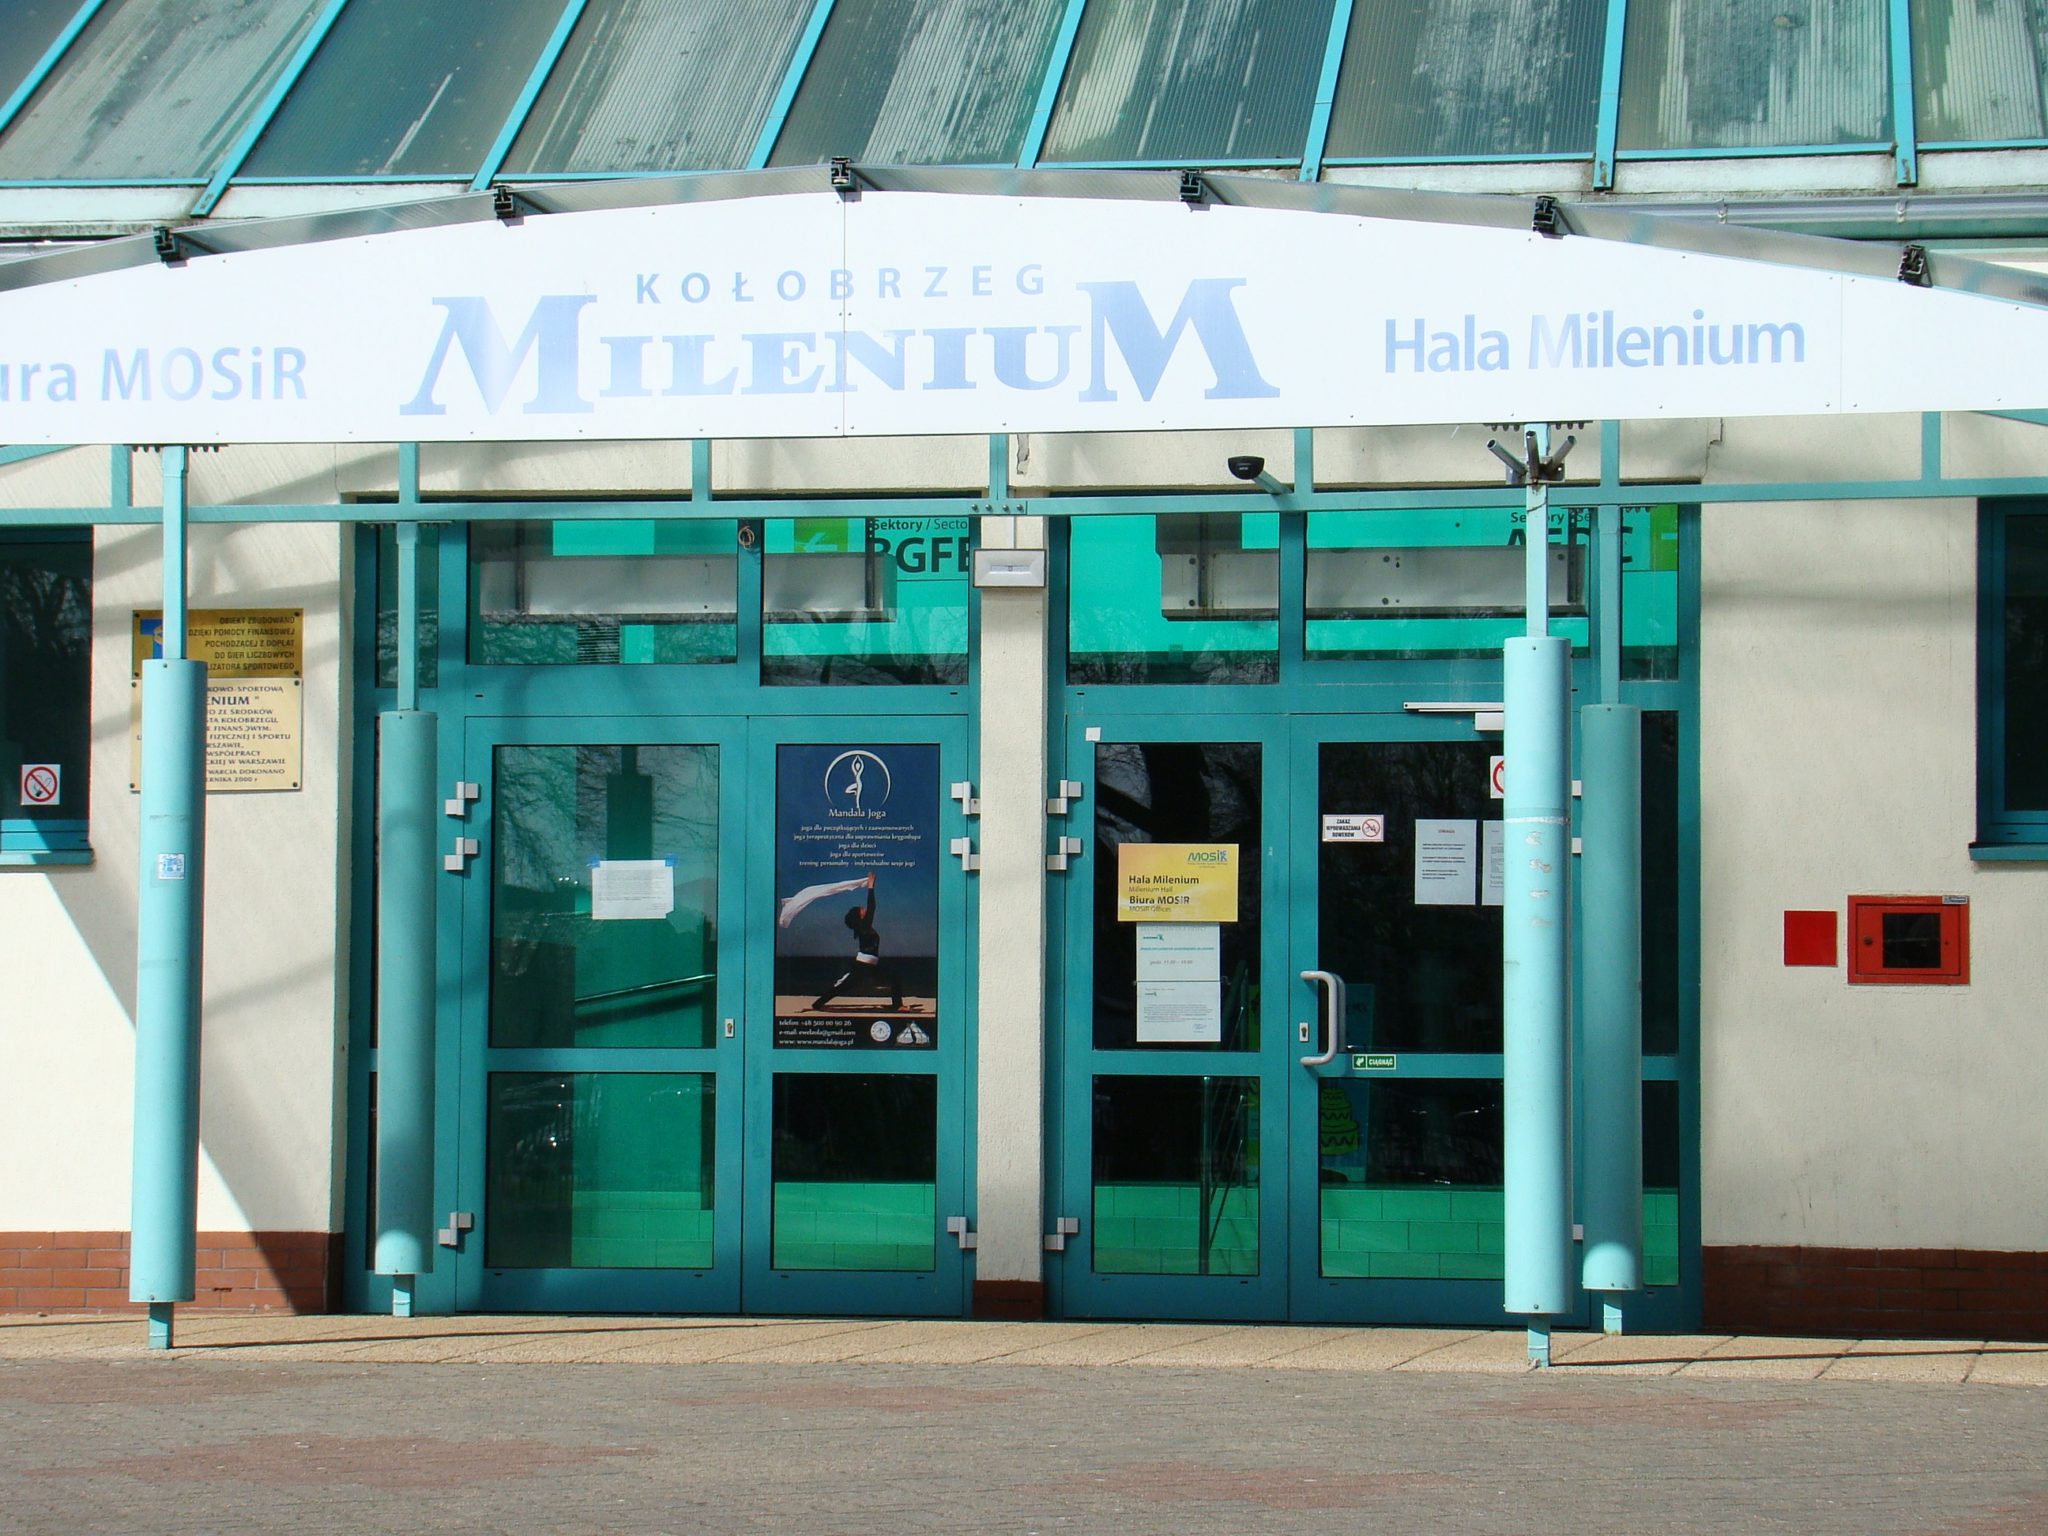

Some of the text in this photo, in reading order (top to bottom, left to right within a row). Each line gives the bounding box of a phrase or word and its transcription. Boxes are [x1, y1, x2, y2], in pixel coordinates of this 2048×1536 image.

[636, 264, 1045, 304] KOŁOBRZEG
[400, 277, 1281, 416] MILENIUM
[1384, 309, 1805, 373] Hala Milenium
[101, 347, 308, 402] MOSiR
[873, 519, 922, 532] Sektory
[829, 808, 886, 820] Mandala Joga
[1129, 875, 1200, 884] Hala Milenium
[1130, 896, 1190, 904] Biura MOSiR
